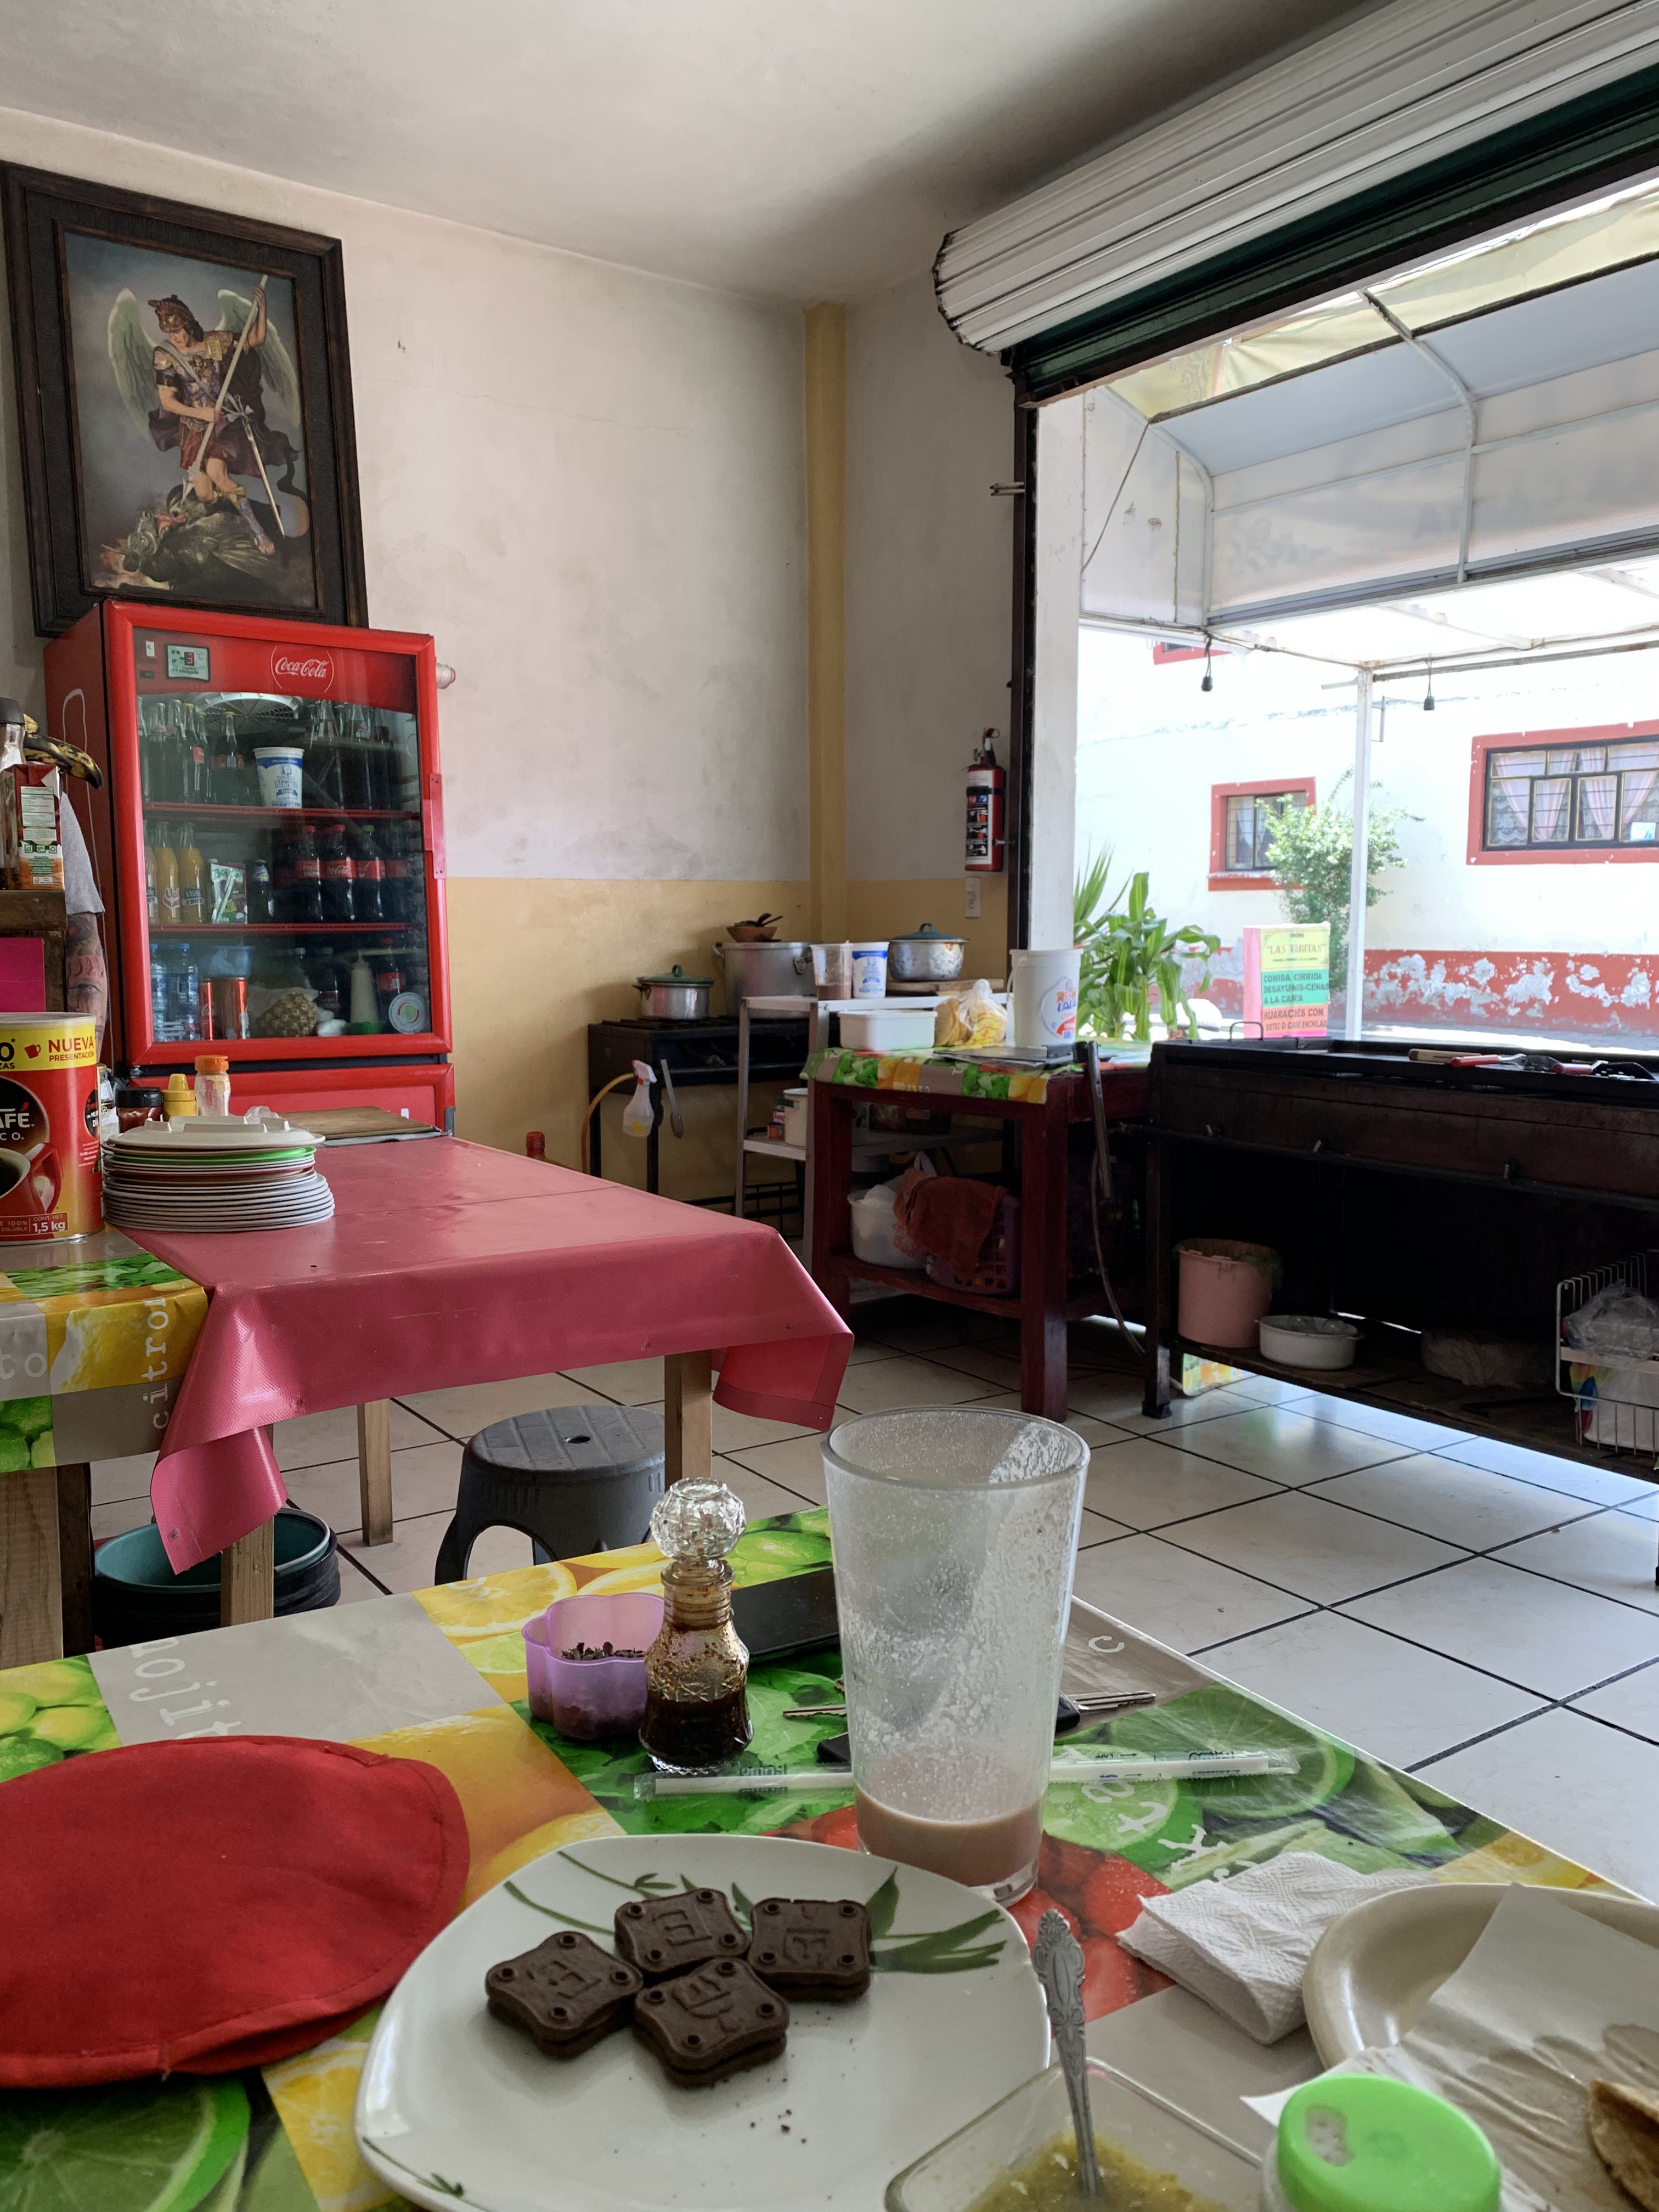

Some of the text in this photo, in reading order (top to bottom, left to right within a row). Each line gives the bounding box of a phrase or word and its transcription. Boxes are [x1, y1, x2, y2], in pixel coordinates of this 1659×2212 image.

[1263, 972, 1322, 983] COMIDA CORRIDA
[1271, 996, 1279, 1004] LA
[1308, 1008, 1324, 1016] CON
[48, 1036, 94, 1053] NUEVA
[49, 1052, 94, 1062] PRESENTACIÓN
[33, 1221, 66, 1234] 1,5 kg
